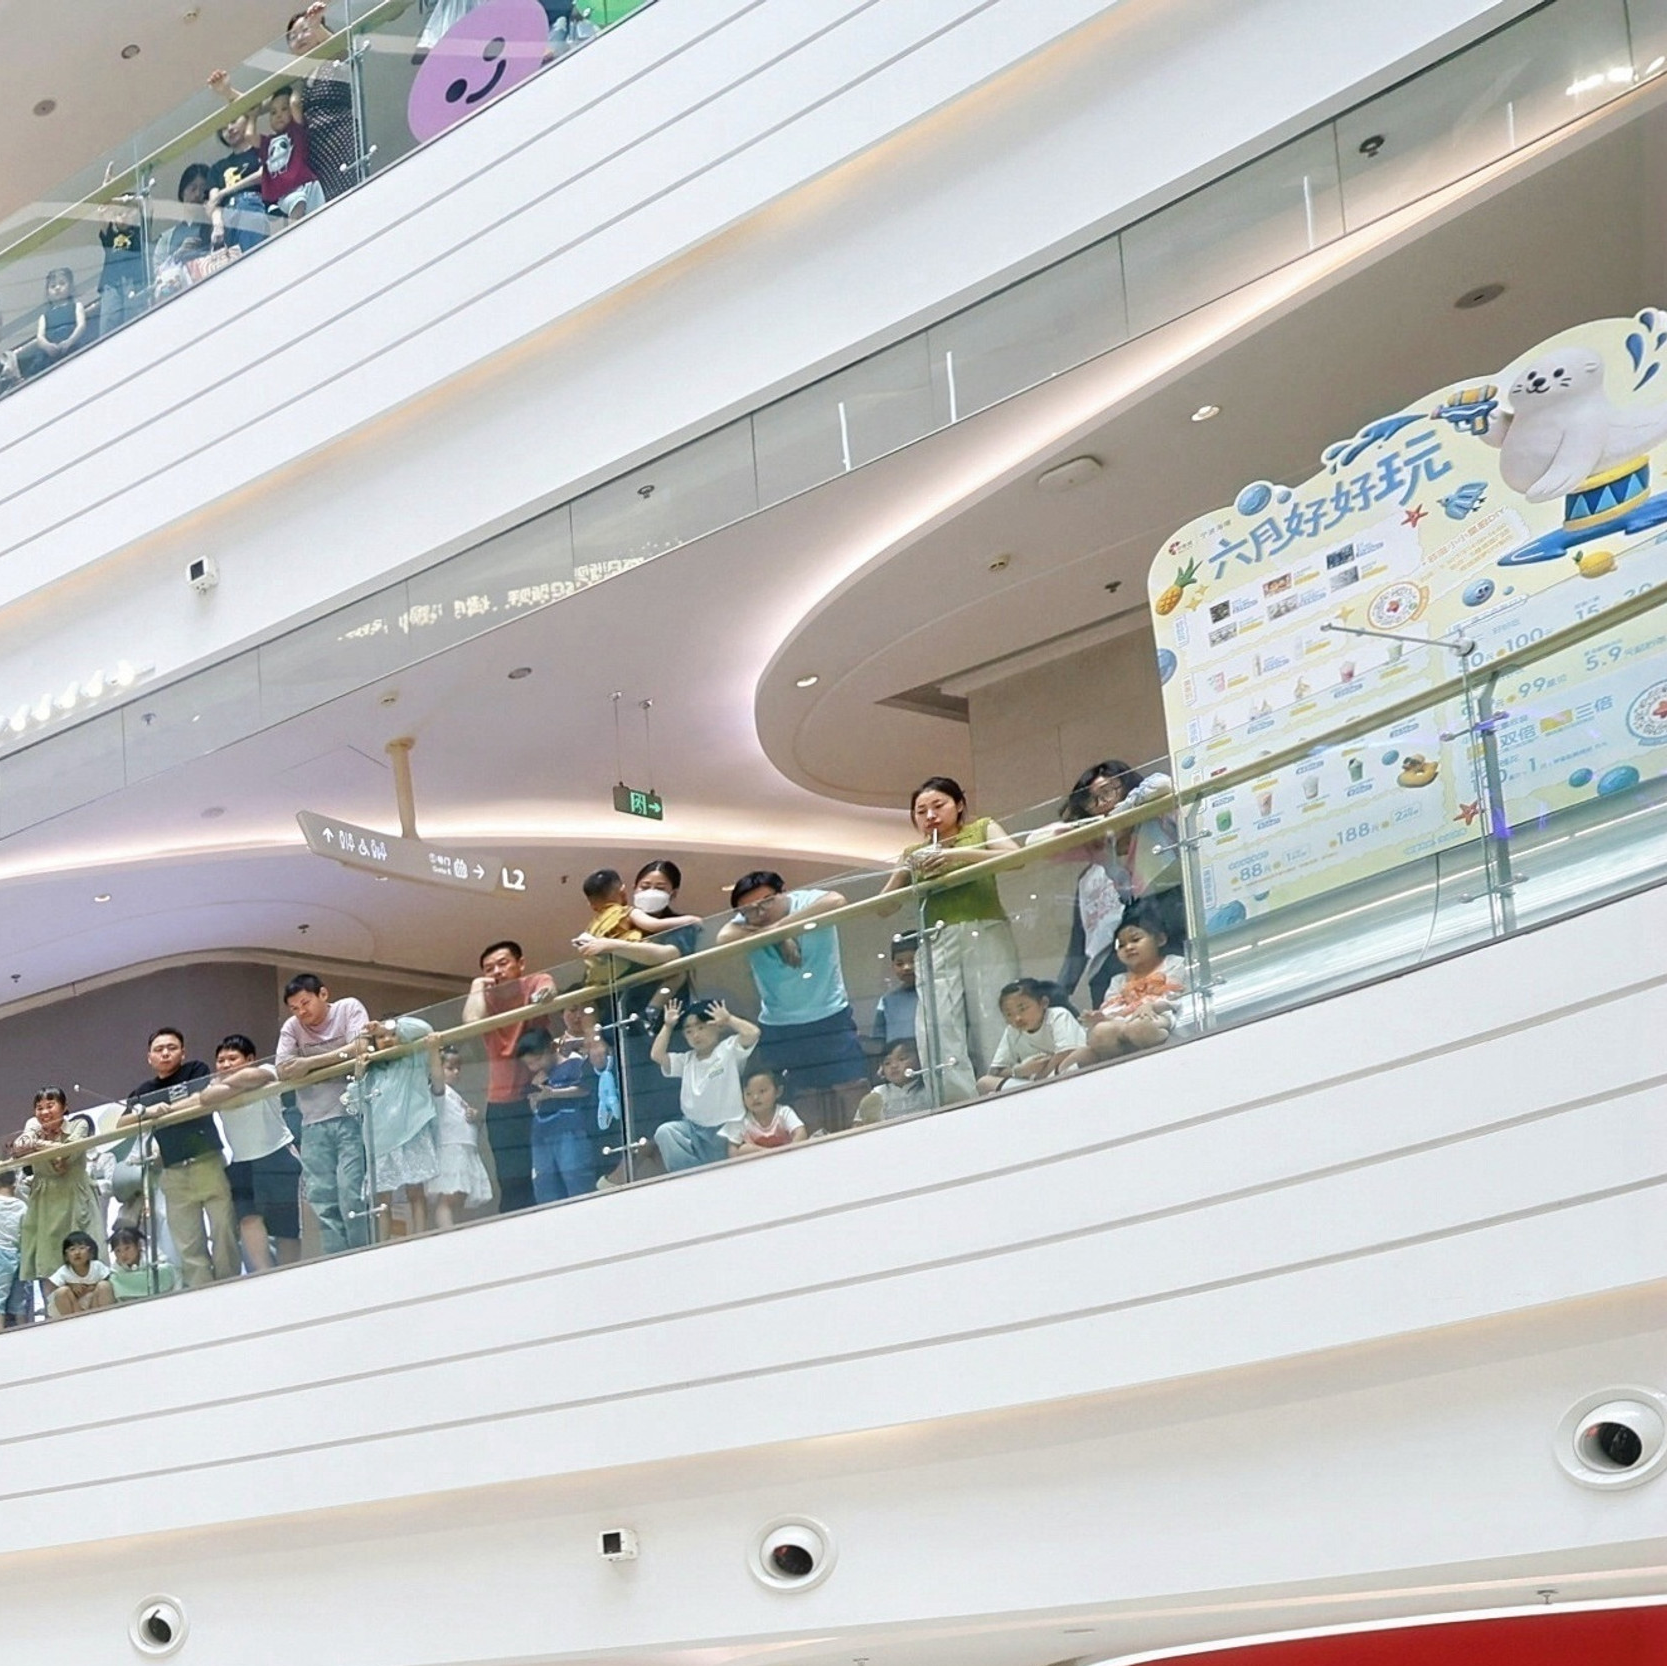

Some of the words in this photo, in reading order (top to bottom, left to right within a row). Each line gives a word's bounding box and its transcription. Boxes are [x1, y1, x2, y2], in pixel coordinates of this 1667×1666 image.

[1209, 429, 1452, 580] 六月好好玩
[501, 867, 526, 891] L2
